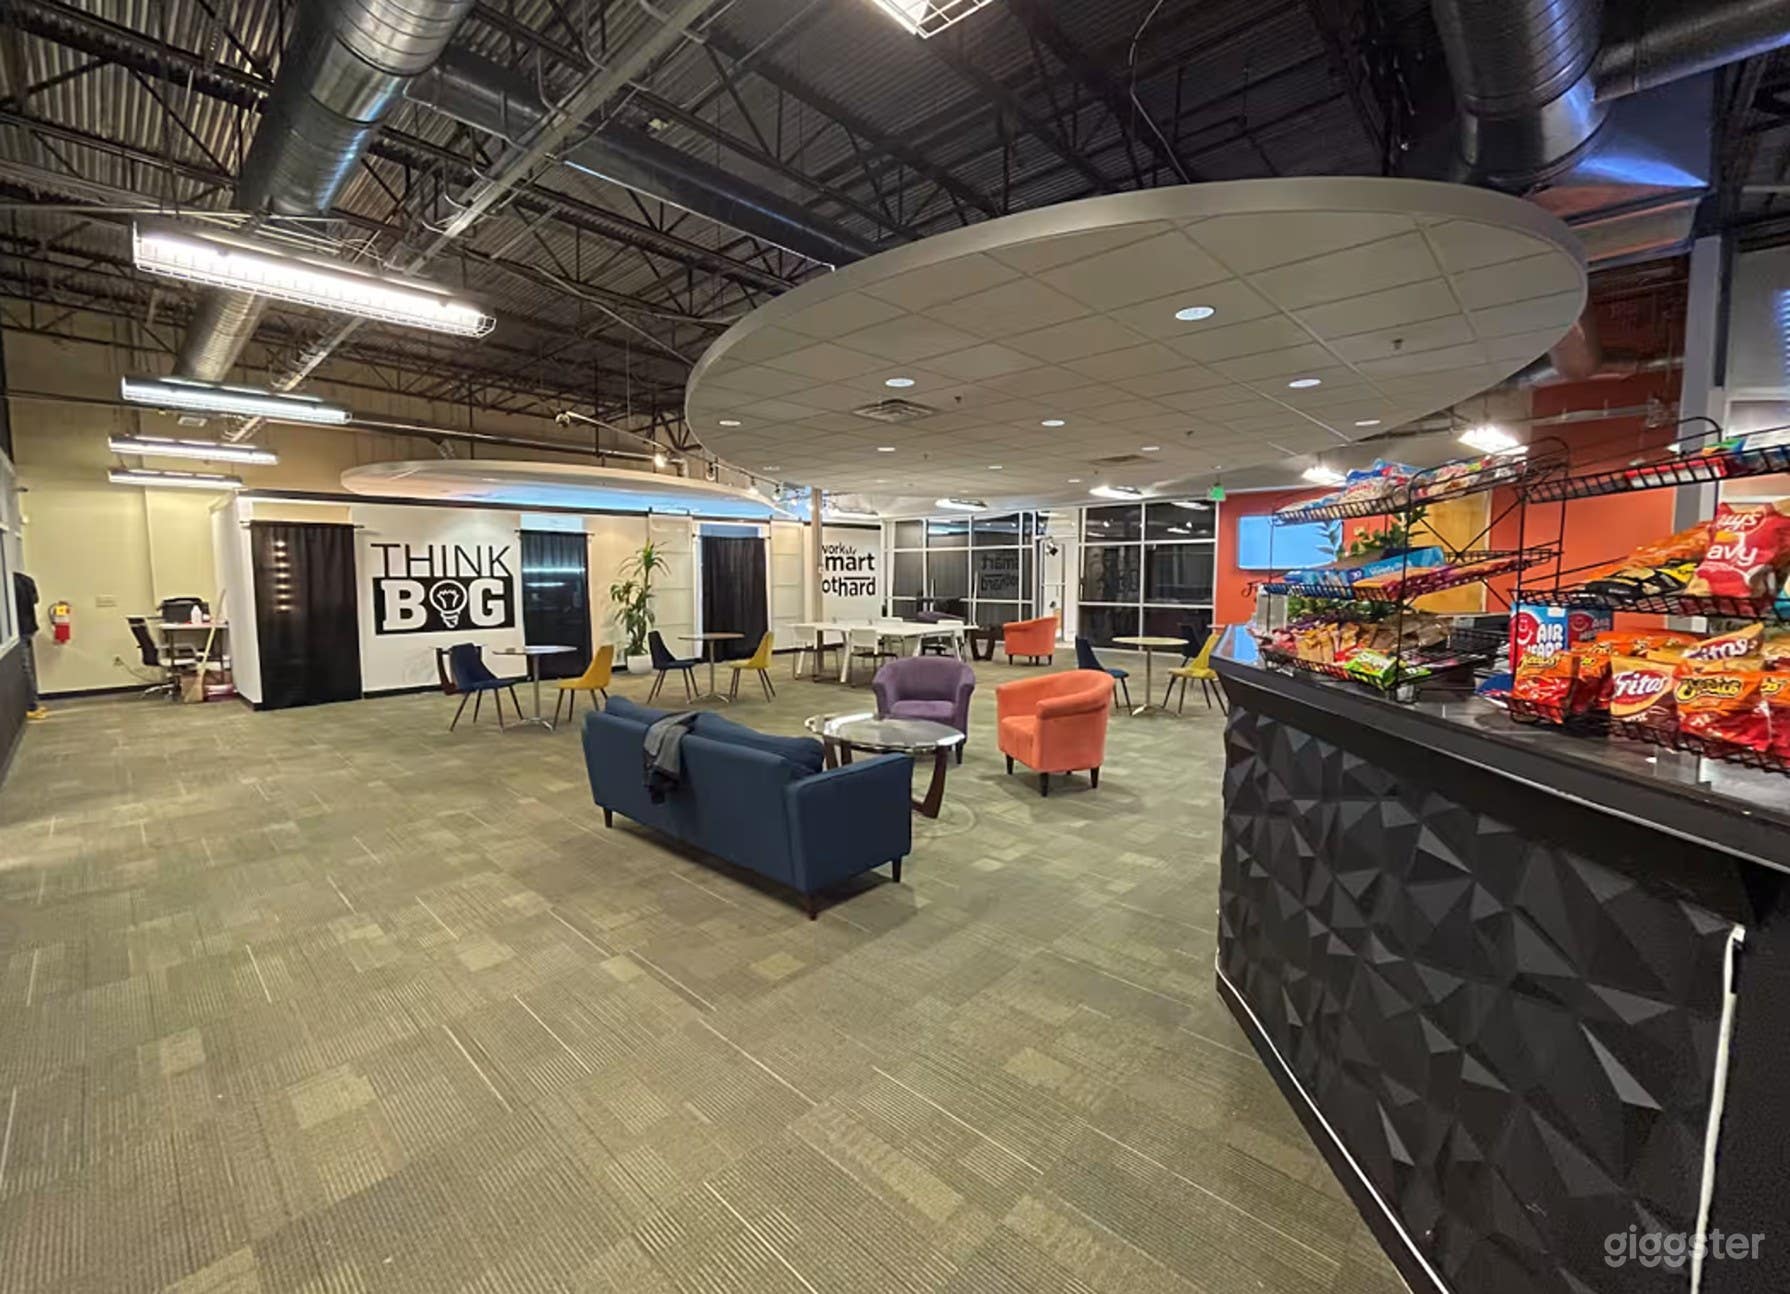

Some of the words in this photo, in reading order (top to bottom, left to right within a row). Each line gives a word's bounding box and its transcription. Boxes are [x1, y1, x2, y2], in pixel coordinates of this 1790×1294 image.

[371, 543, 514, 578] THINK
[825, 552, 876, 571] mart
[1706, 544, 1758, 567] avy
[821, 577, 838, 594] ot
[838, 576, 876, 597] hard
[1537, 624, 1563, 642] AIR
